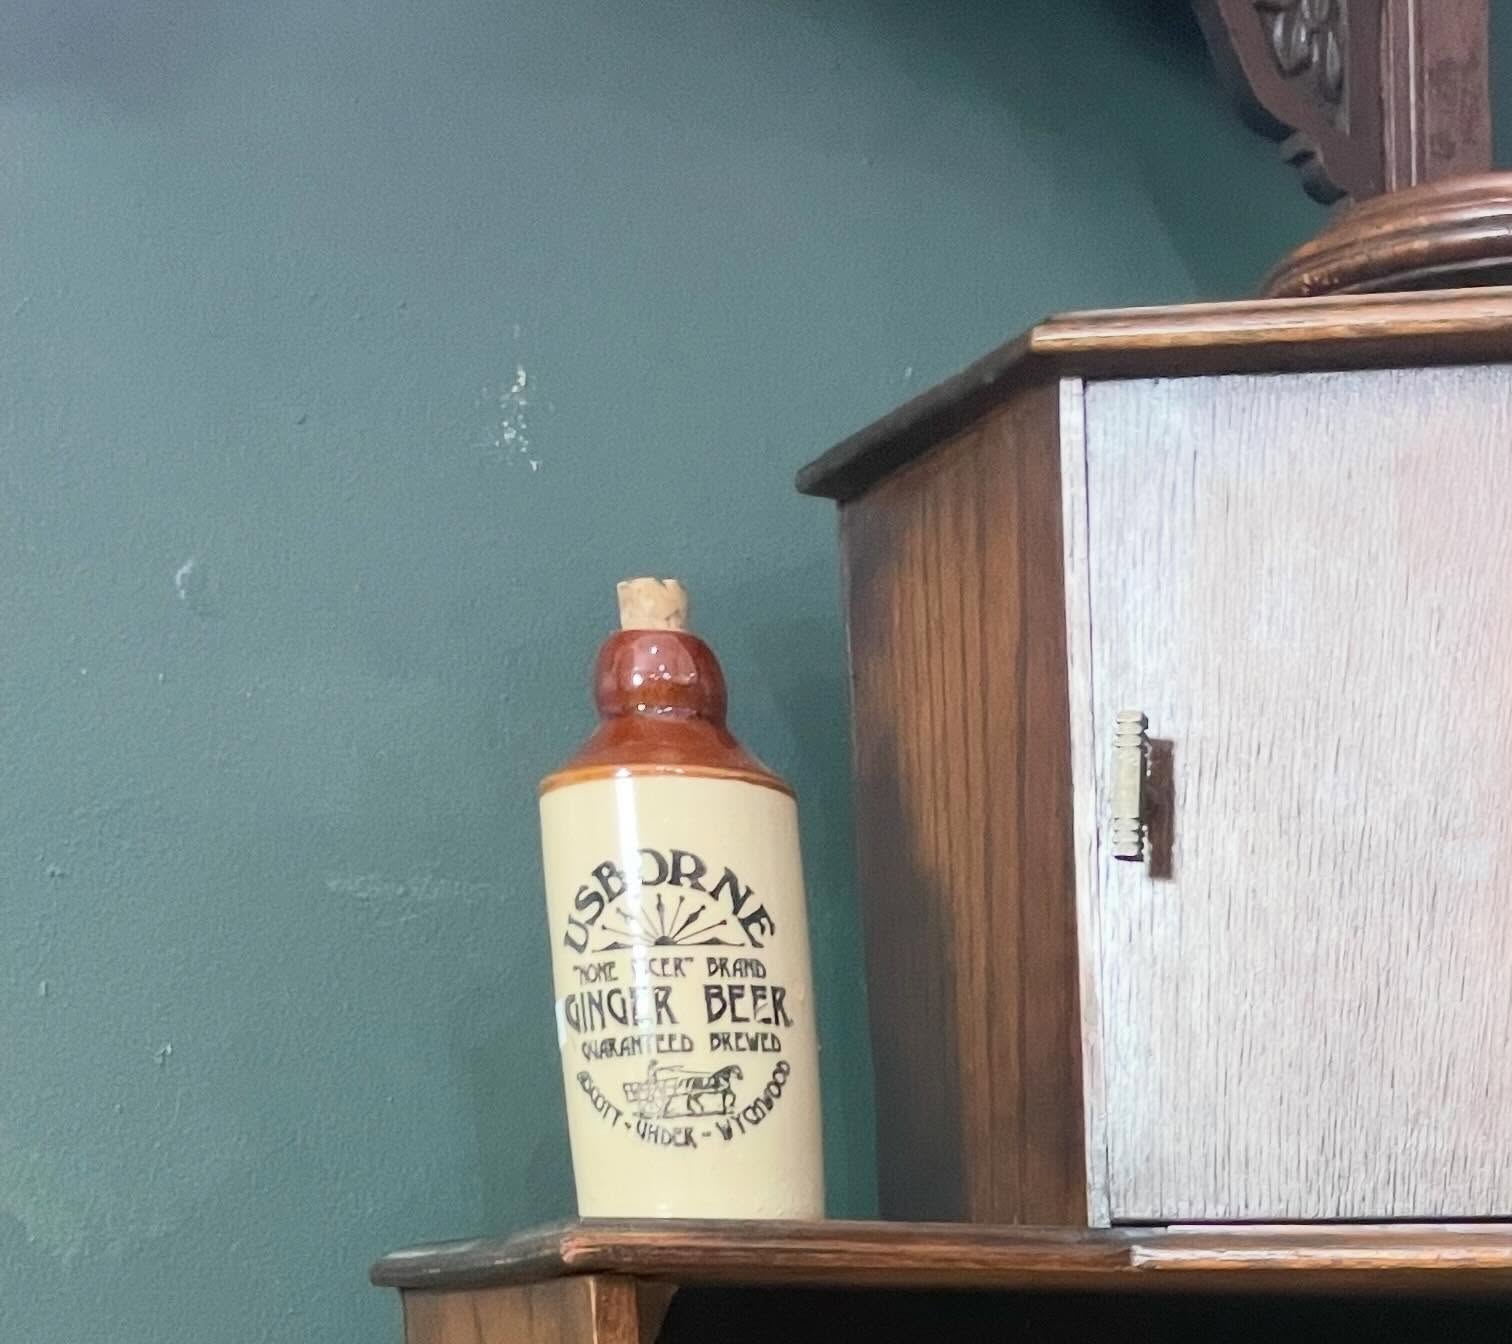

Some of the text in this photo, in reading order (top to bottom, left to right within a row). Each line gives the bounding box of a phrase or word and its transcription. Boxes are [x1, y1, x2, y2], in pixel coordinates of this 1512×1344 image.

[564, 848, 775, 953] USBORNE
[706, 957, 766, 979] BRAND
[565, 984, 793, 1033] GINGER BEER
[710, 1031, 781, 1052] BREWED
